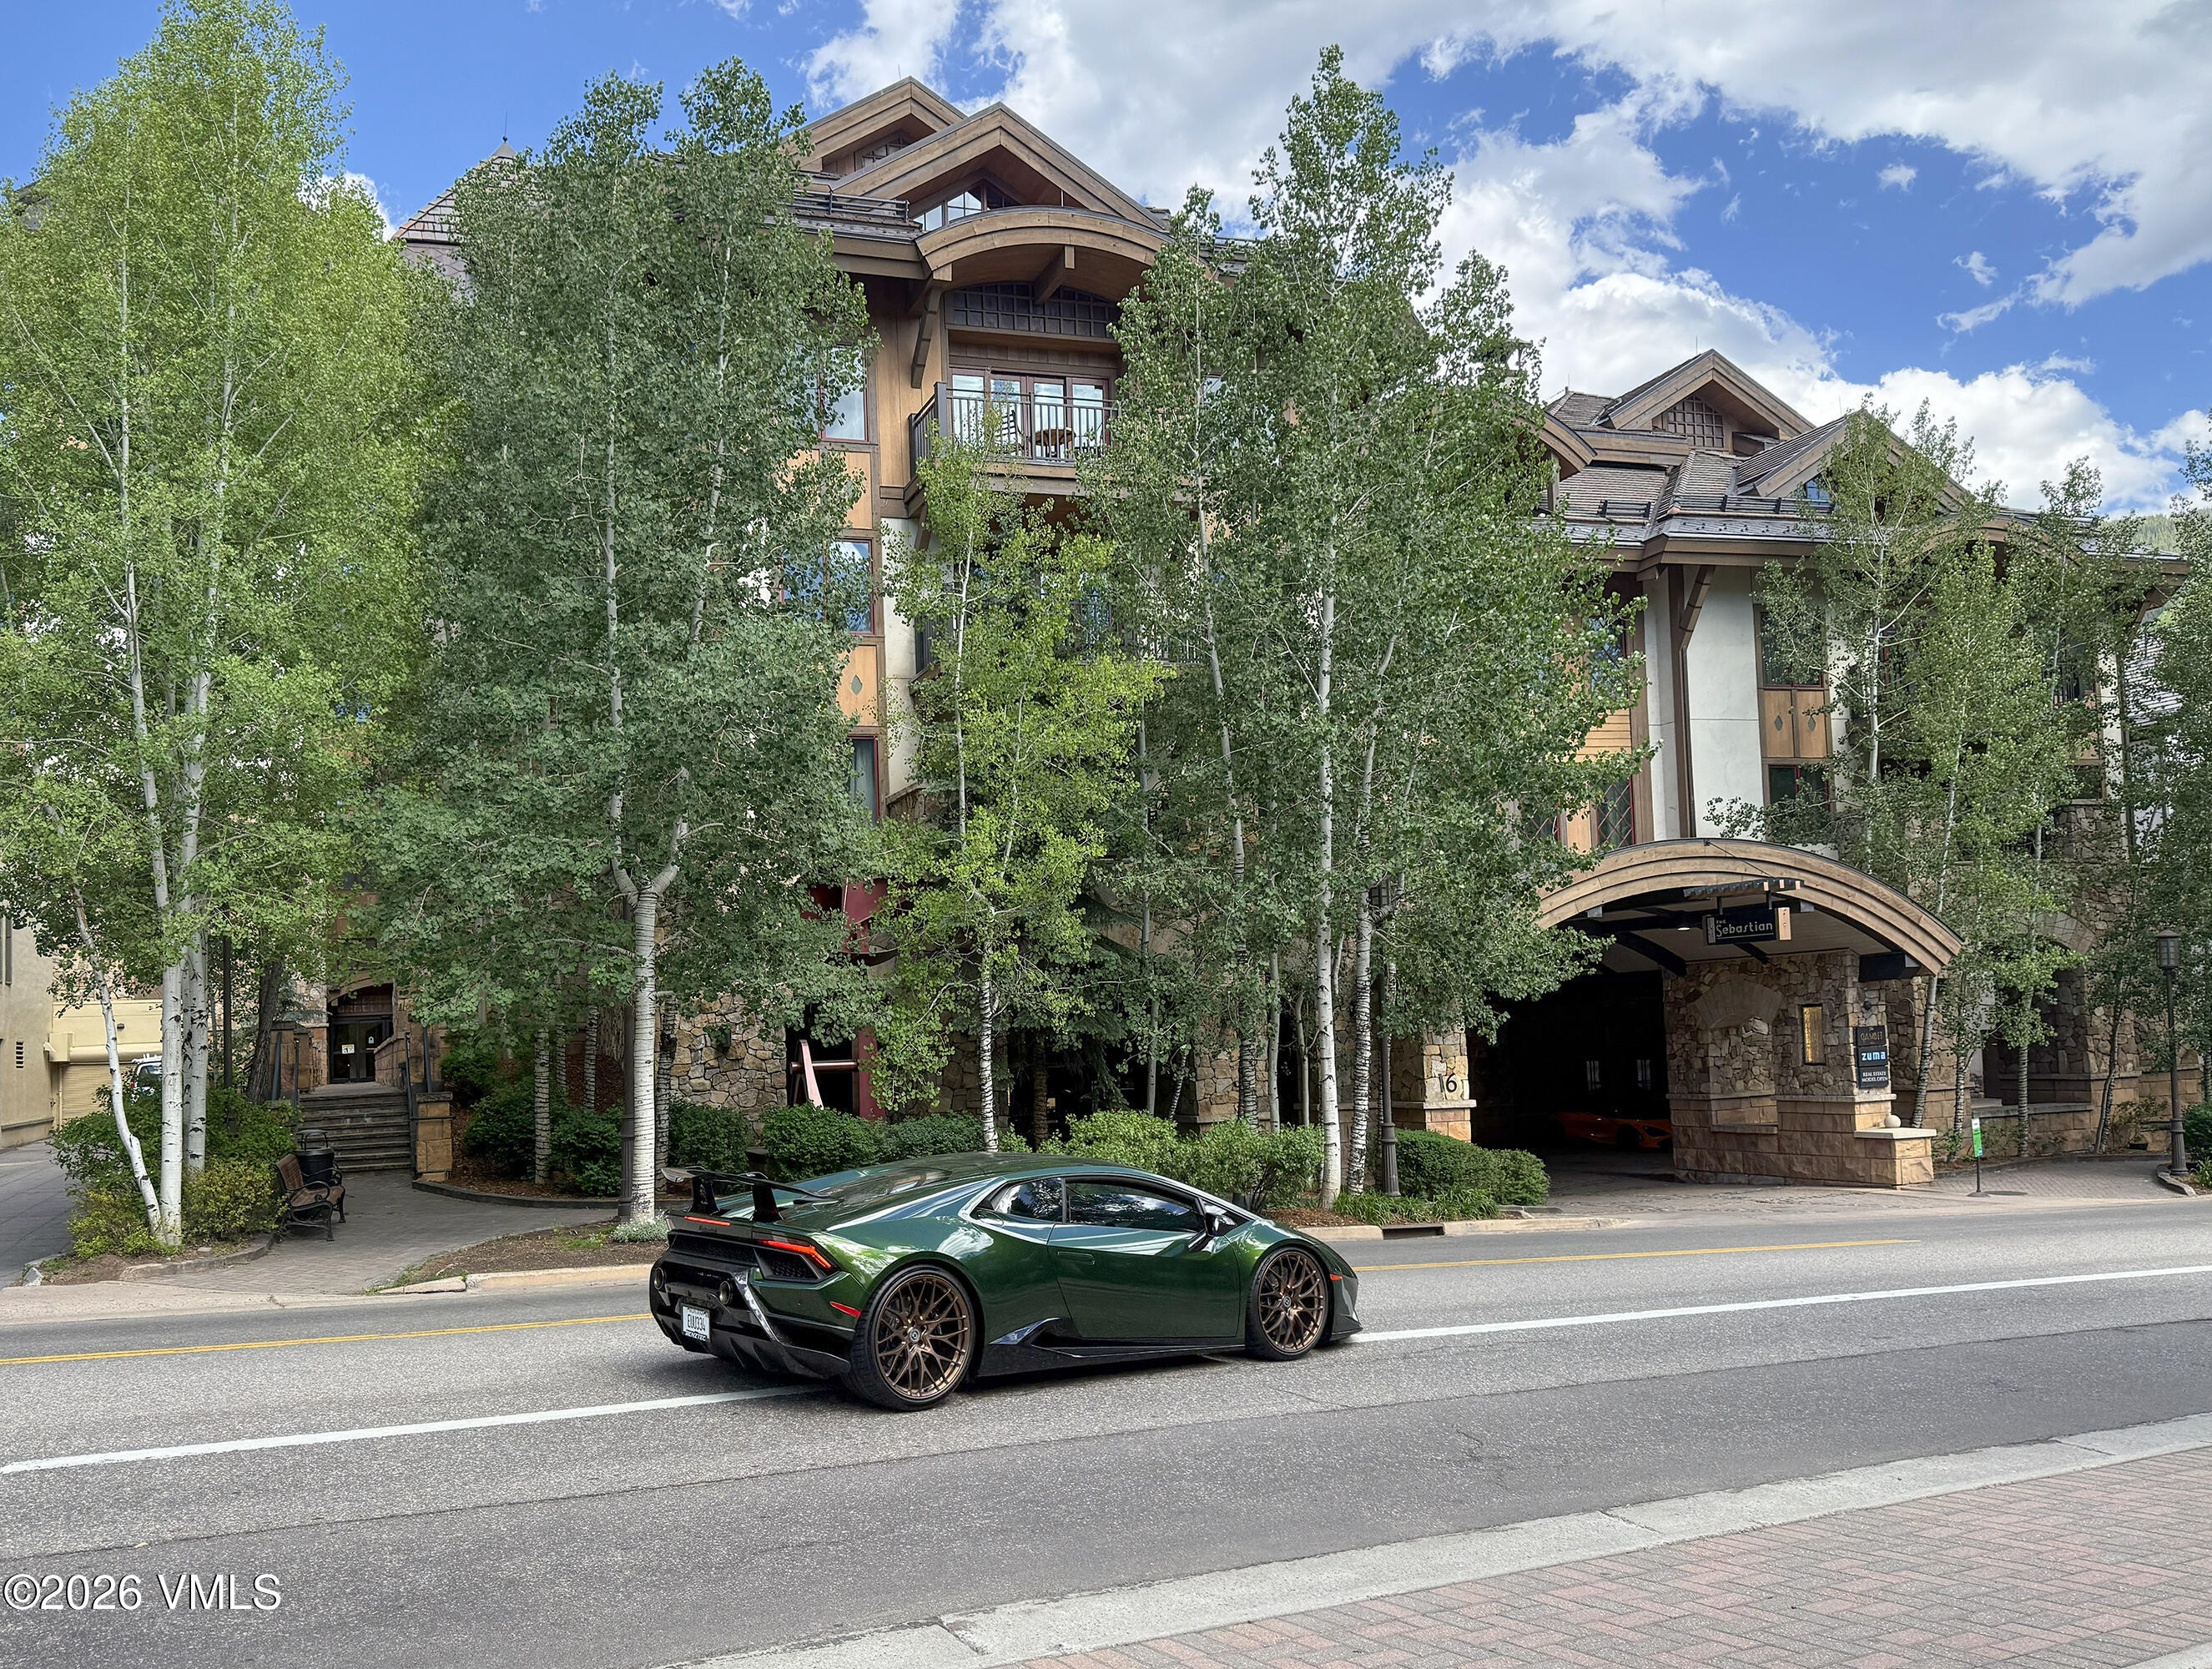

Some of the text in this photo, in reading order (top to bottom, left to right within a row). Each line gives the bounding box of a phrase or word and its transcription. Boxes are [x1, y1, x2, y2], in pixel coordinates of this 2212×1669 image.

[1716, 921, 1773, 937] Sebastian
[1861, 1051, 1886, 1061] zuma
[1438, 1072, 1457, 1092] 16
